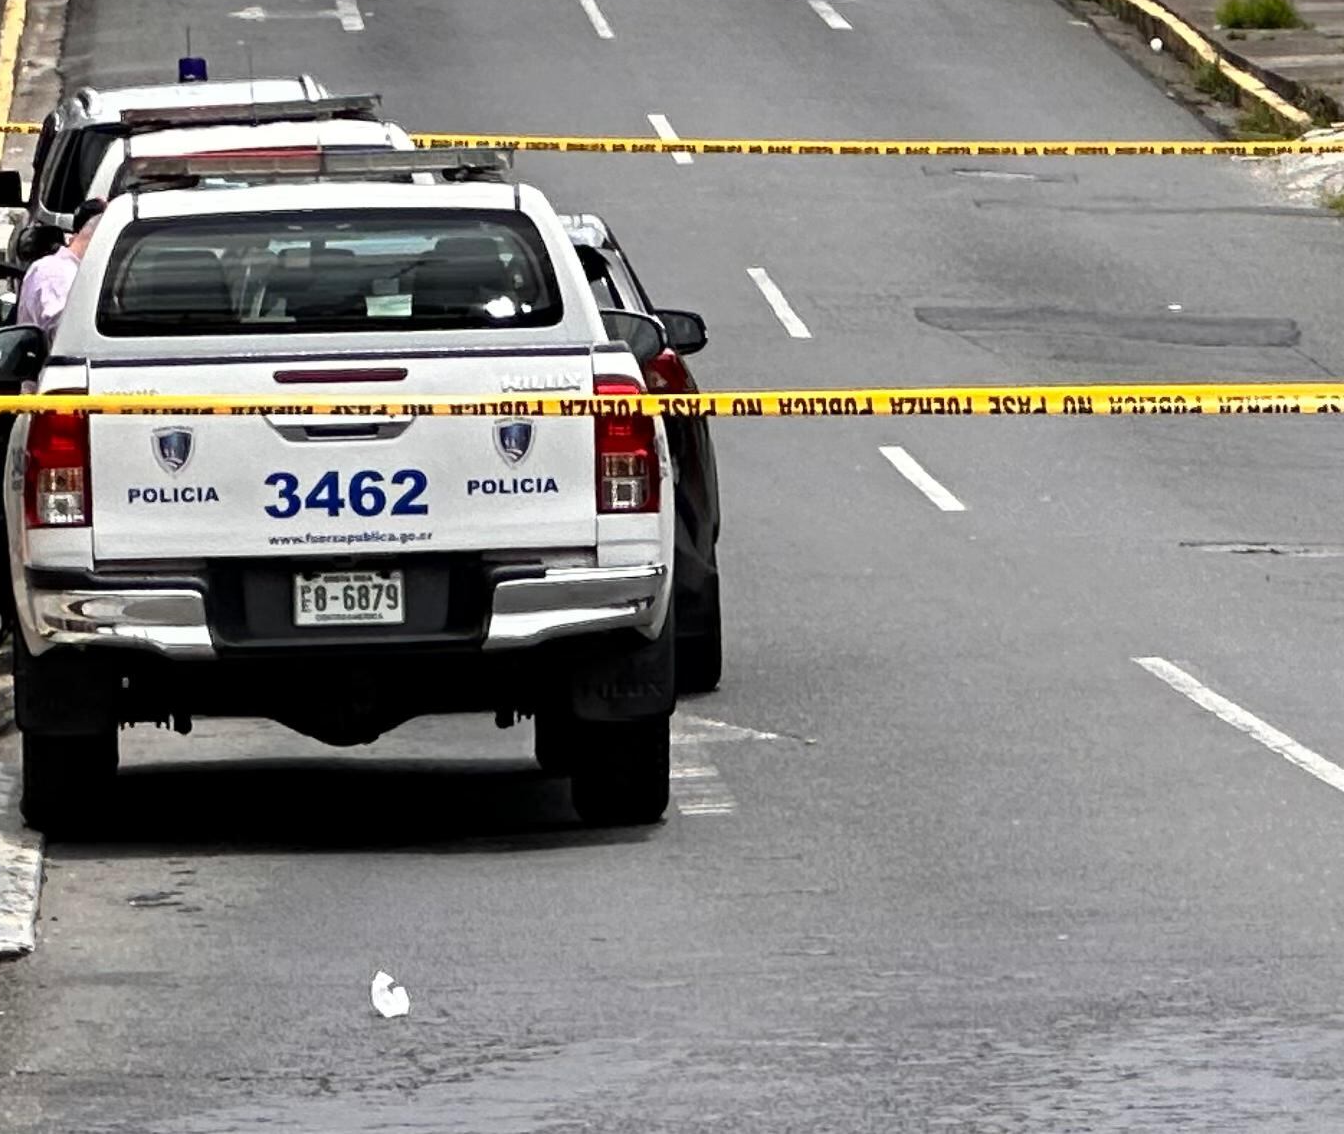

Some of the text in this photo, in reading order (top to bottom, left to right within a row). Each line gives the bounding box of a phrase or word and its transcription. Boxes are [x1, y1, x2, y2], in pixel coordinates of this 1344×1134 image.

[128, 486, 219, 504] POLICIA
[264, 469, 429, 519] 3462
[467, 477, 559, 495] POLICIA
[314, 583, 399, 612] 8-6879
